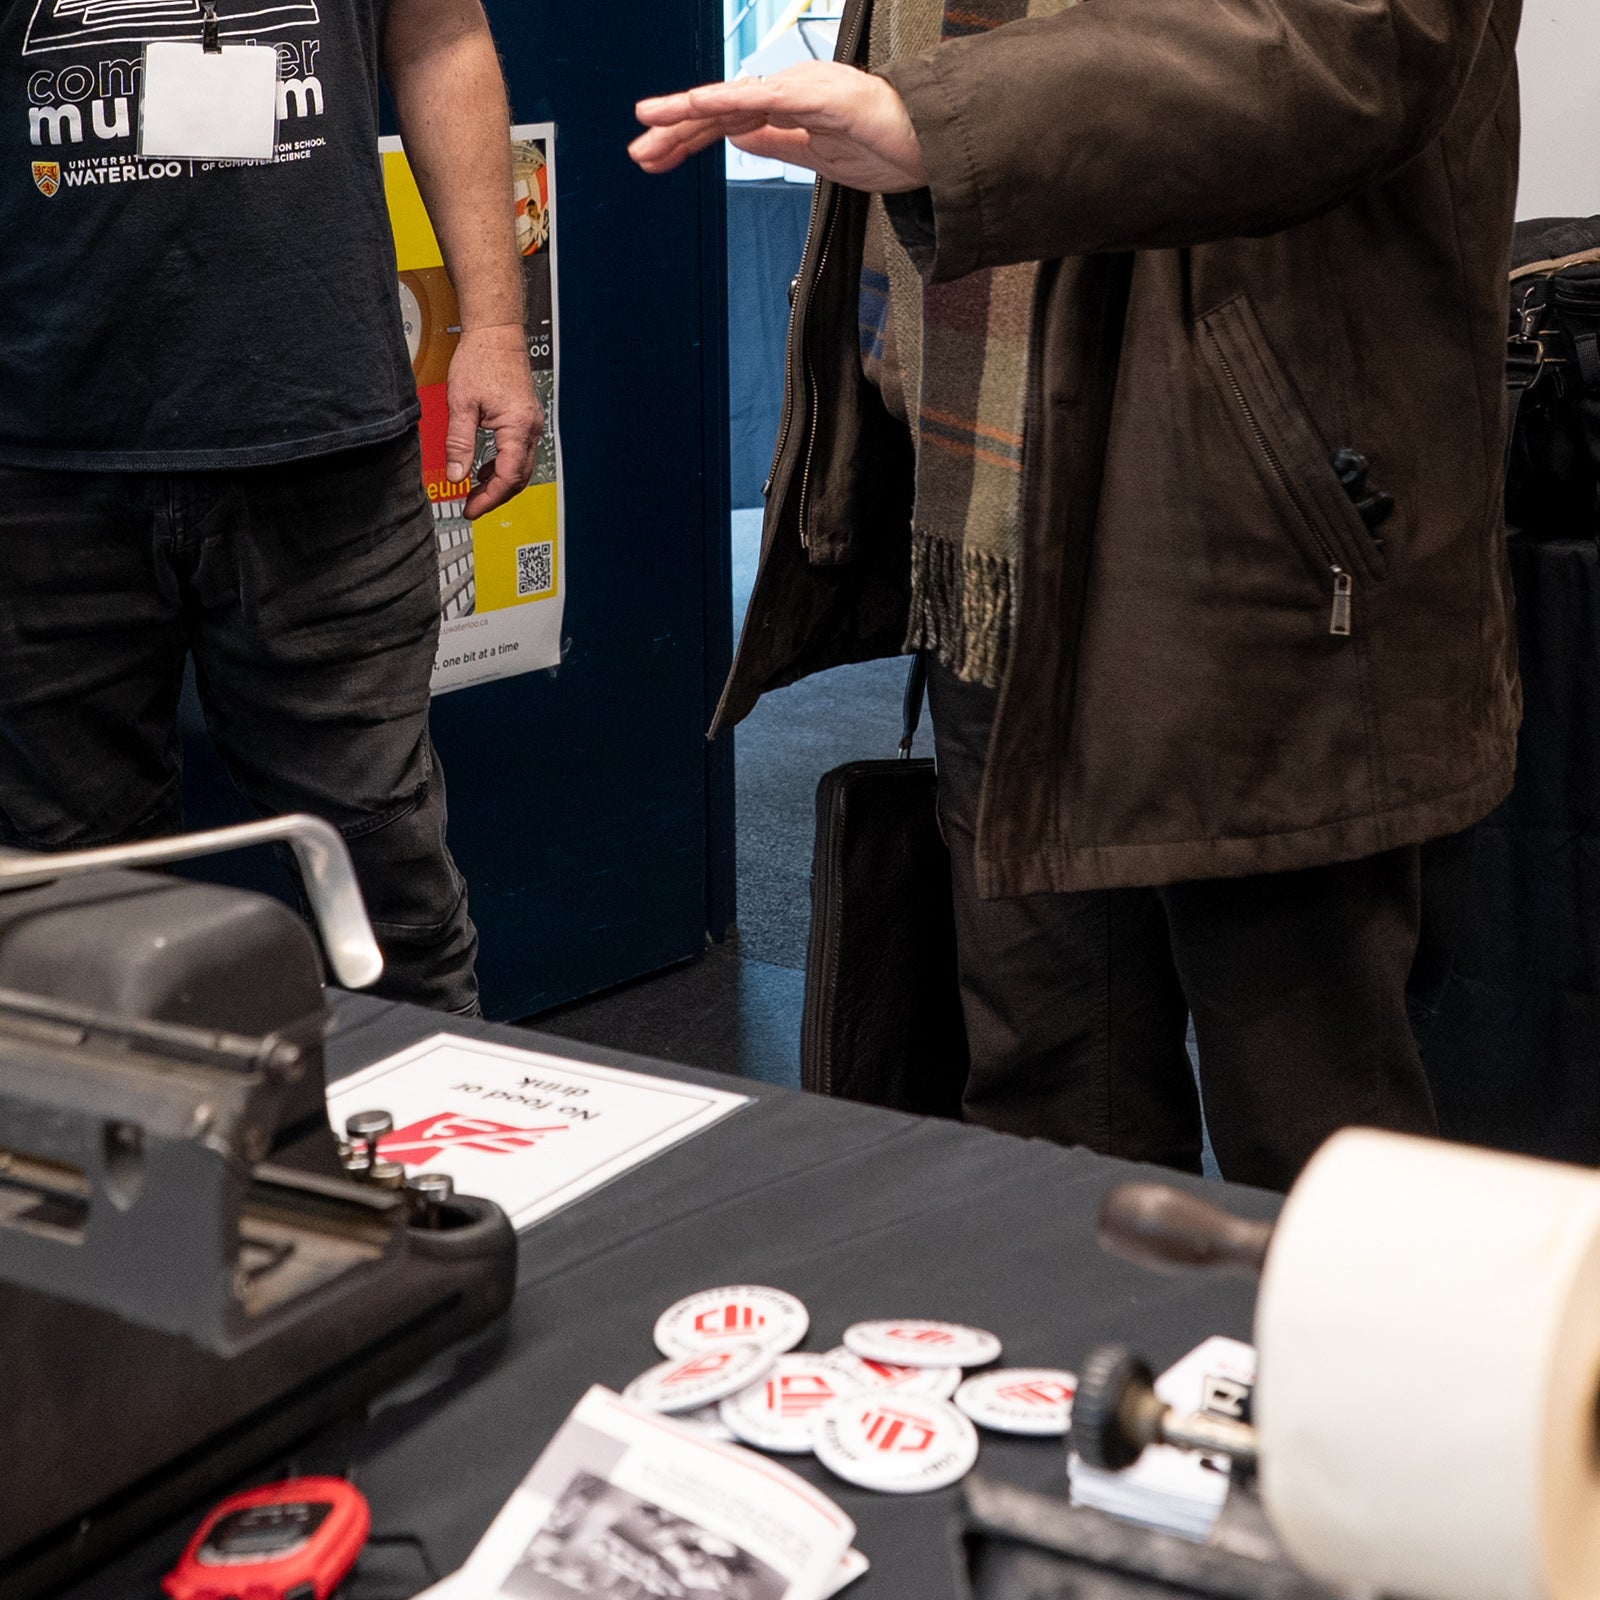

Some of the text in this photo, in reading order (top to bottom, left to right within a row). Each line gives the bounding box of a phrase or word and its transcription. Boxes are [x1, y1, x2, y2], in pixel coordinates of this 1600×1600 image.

[28, 76, 324, 145] mum
[294, 137, 327, 151] SCHOOL
[201, 161, 217, 171] OF
[274, 149, 312, 164] SCIENCE
[63, 161, 182, 188] WATERLOO
[443, 642, 519, 668] one bit at a time
[519, 1077, 590, 1097] drink
[451, 1080, 601, 1121] No food or
